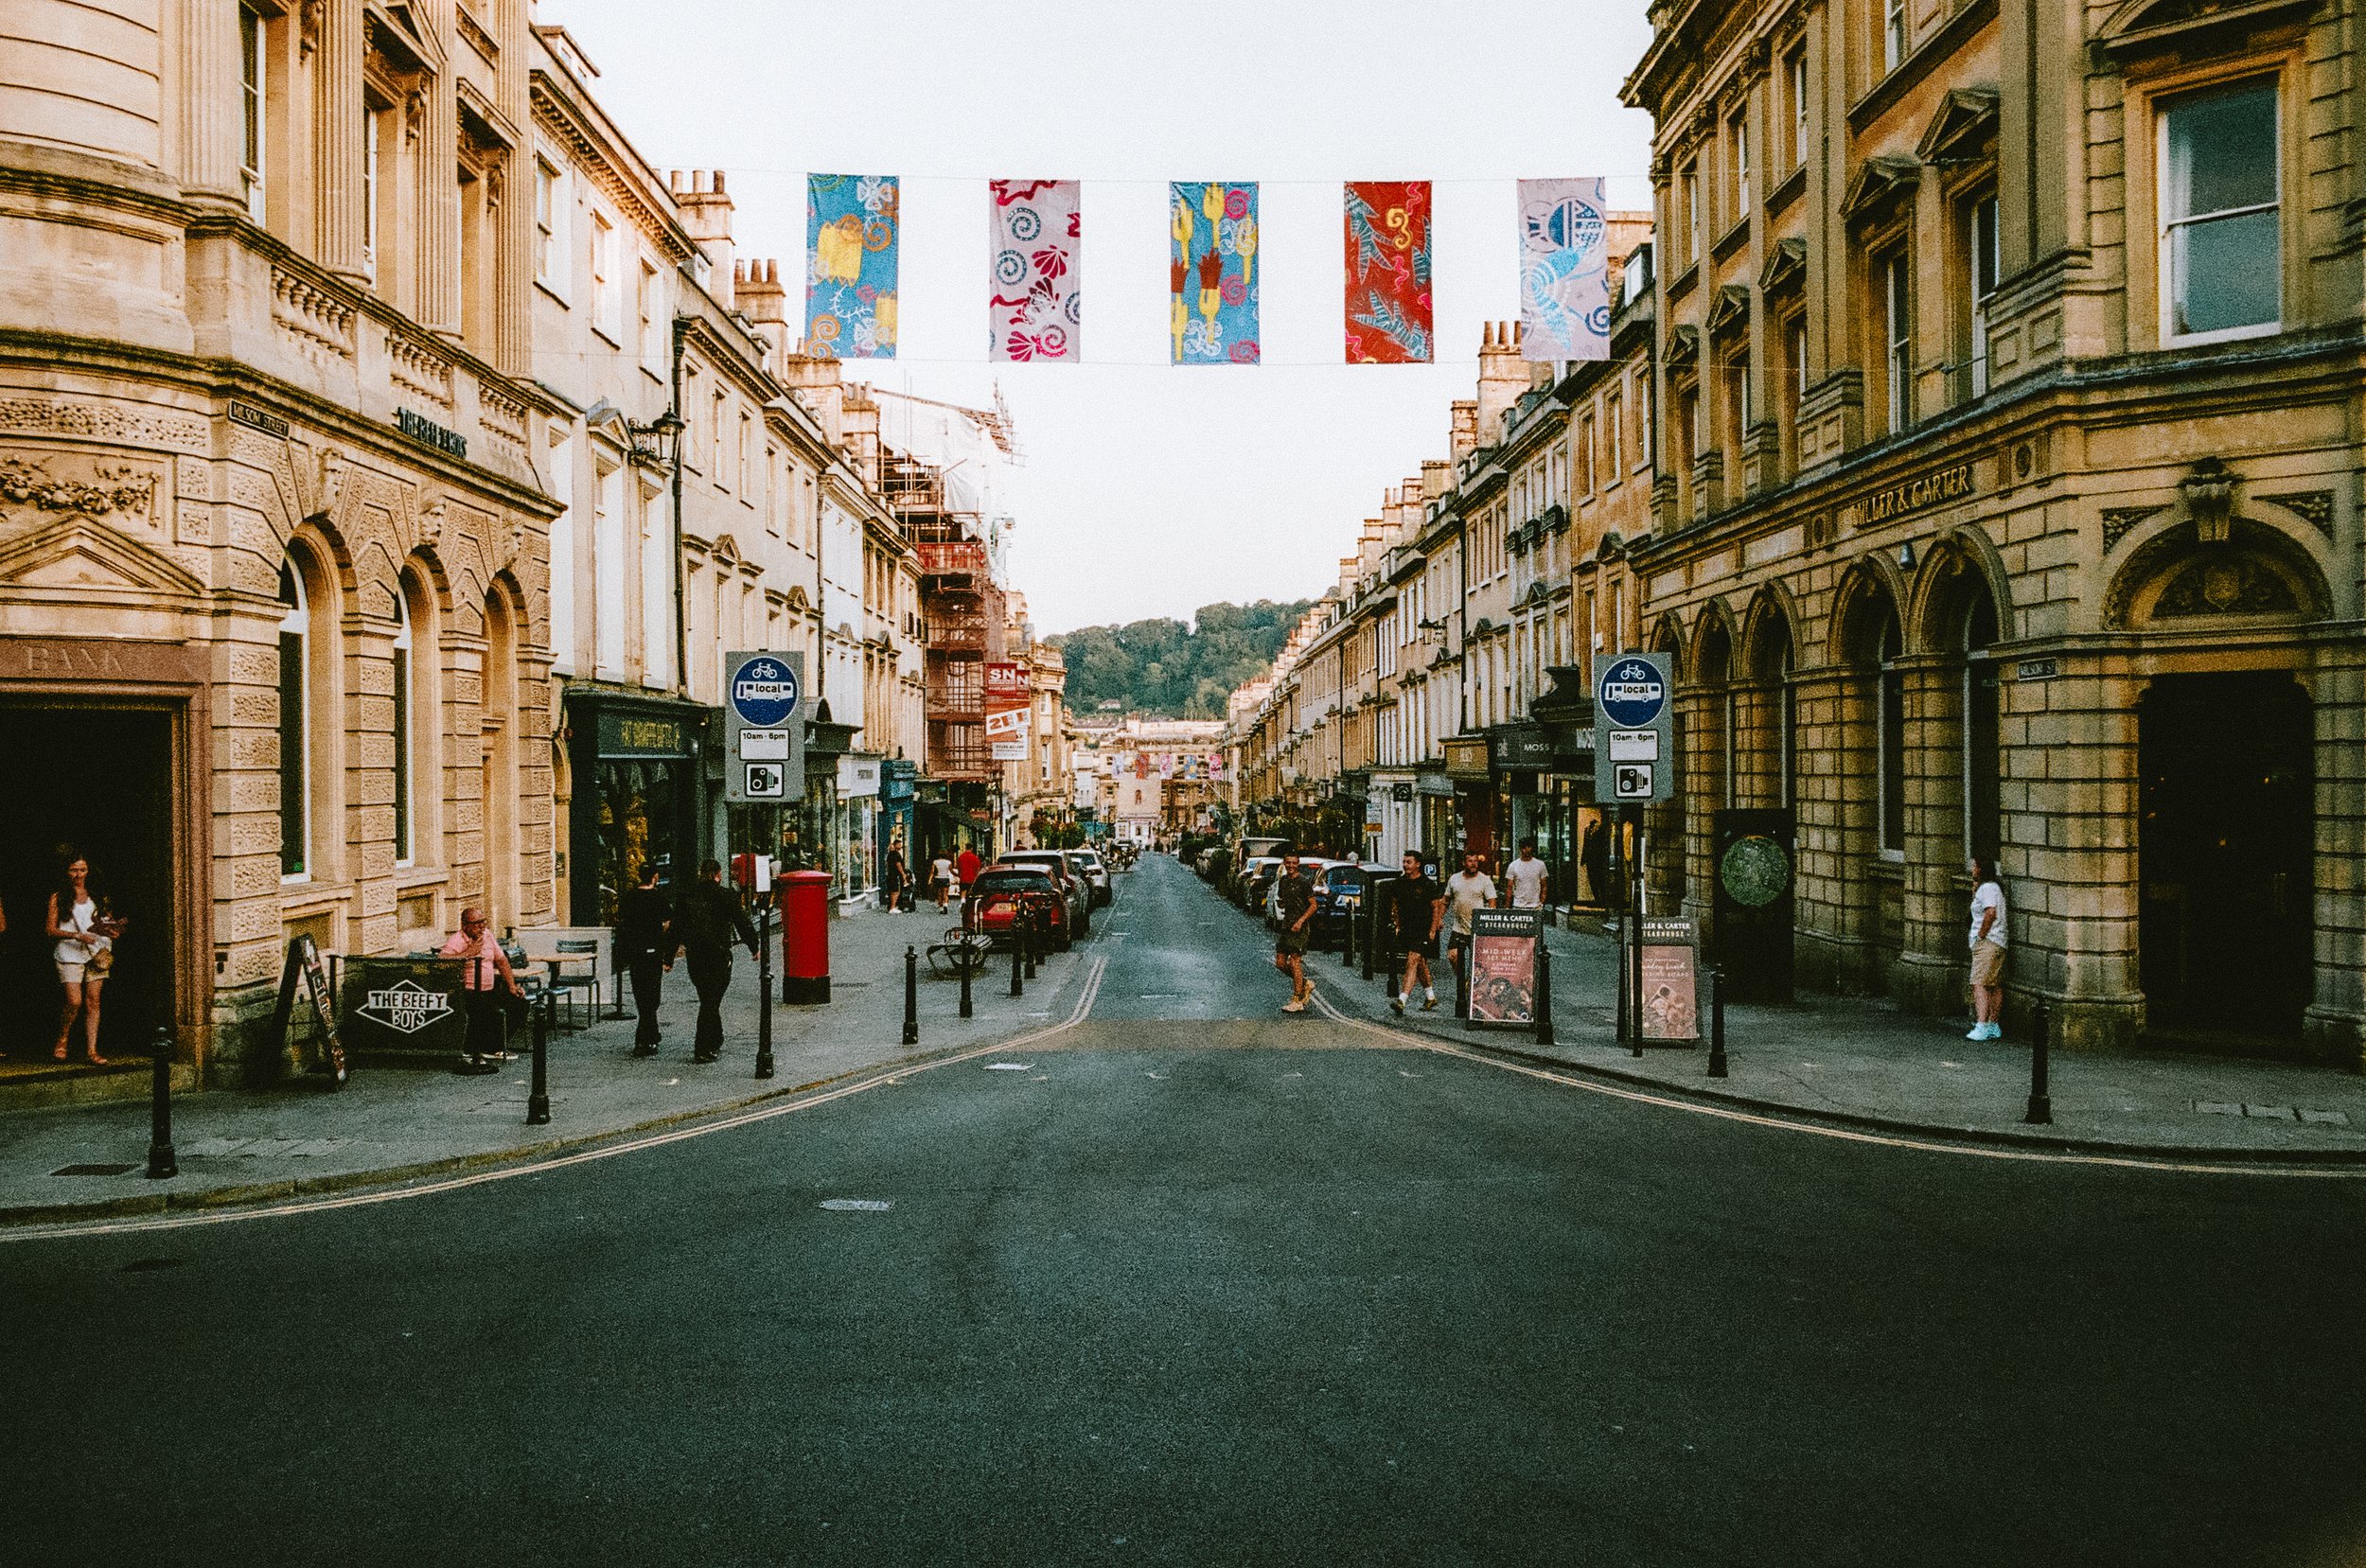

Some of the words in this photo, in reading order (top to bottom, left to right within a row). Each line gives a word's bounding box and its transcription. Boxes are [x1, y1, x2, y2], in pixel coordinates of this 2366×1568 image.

[1898, 486, 1910, 513] &
[1912, 466, 1969, 507] CARTER
[23, 646, 123, 673] BANK
[755, 683, 781, 693] local
[1623, 685, 1649, 694] local
[1524, 743, 1549, 751] MOSS
[371, 992, 399, 1008] THE
[401, 992, 444, 1009] BEEFY
[392, 1009, 426, 1029] BOYS
